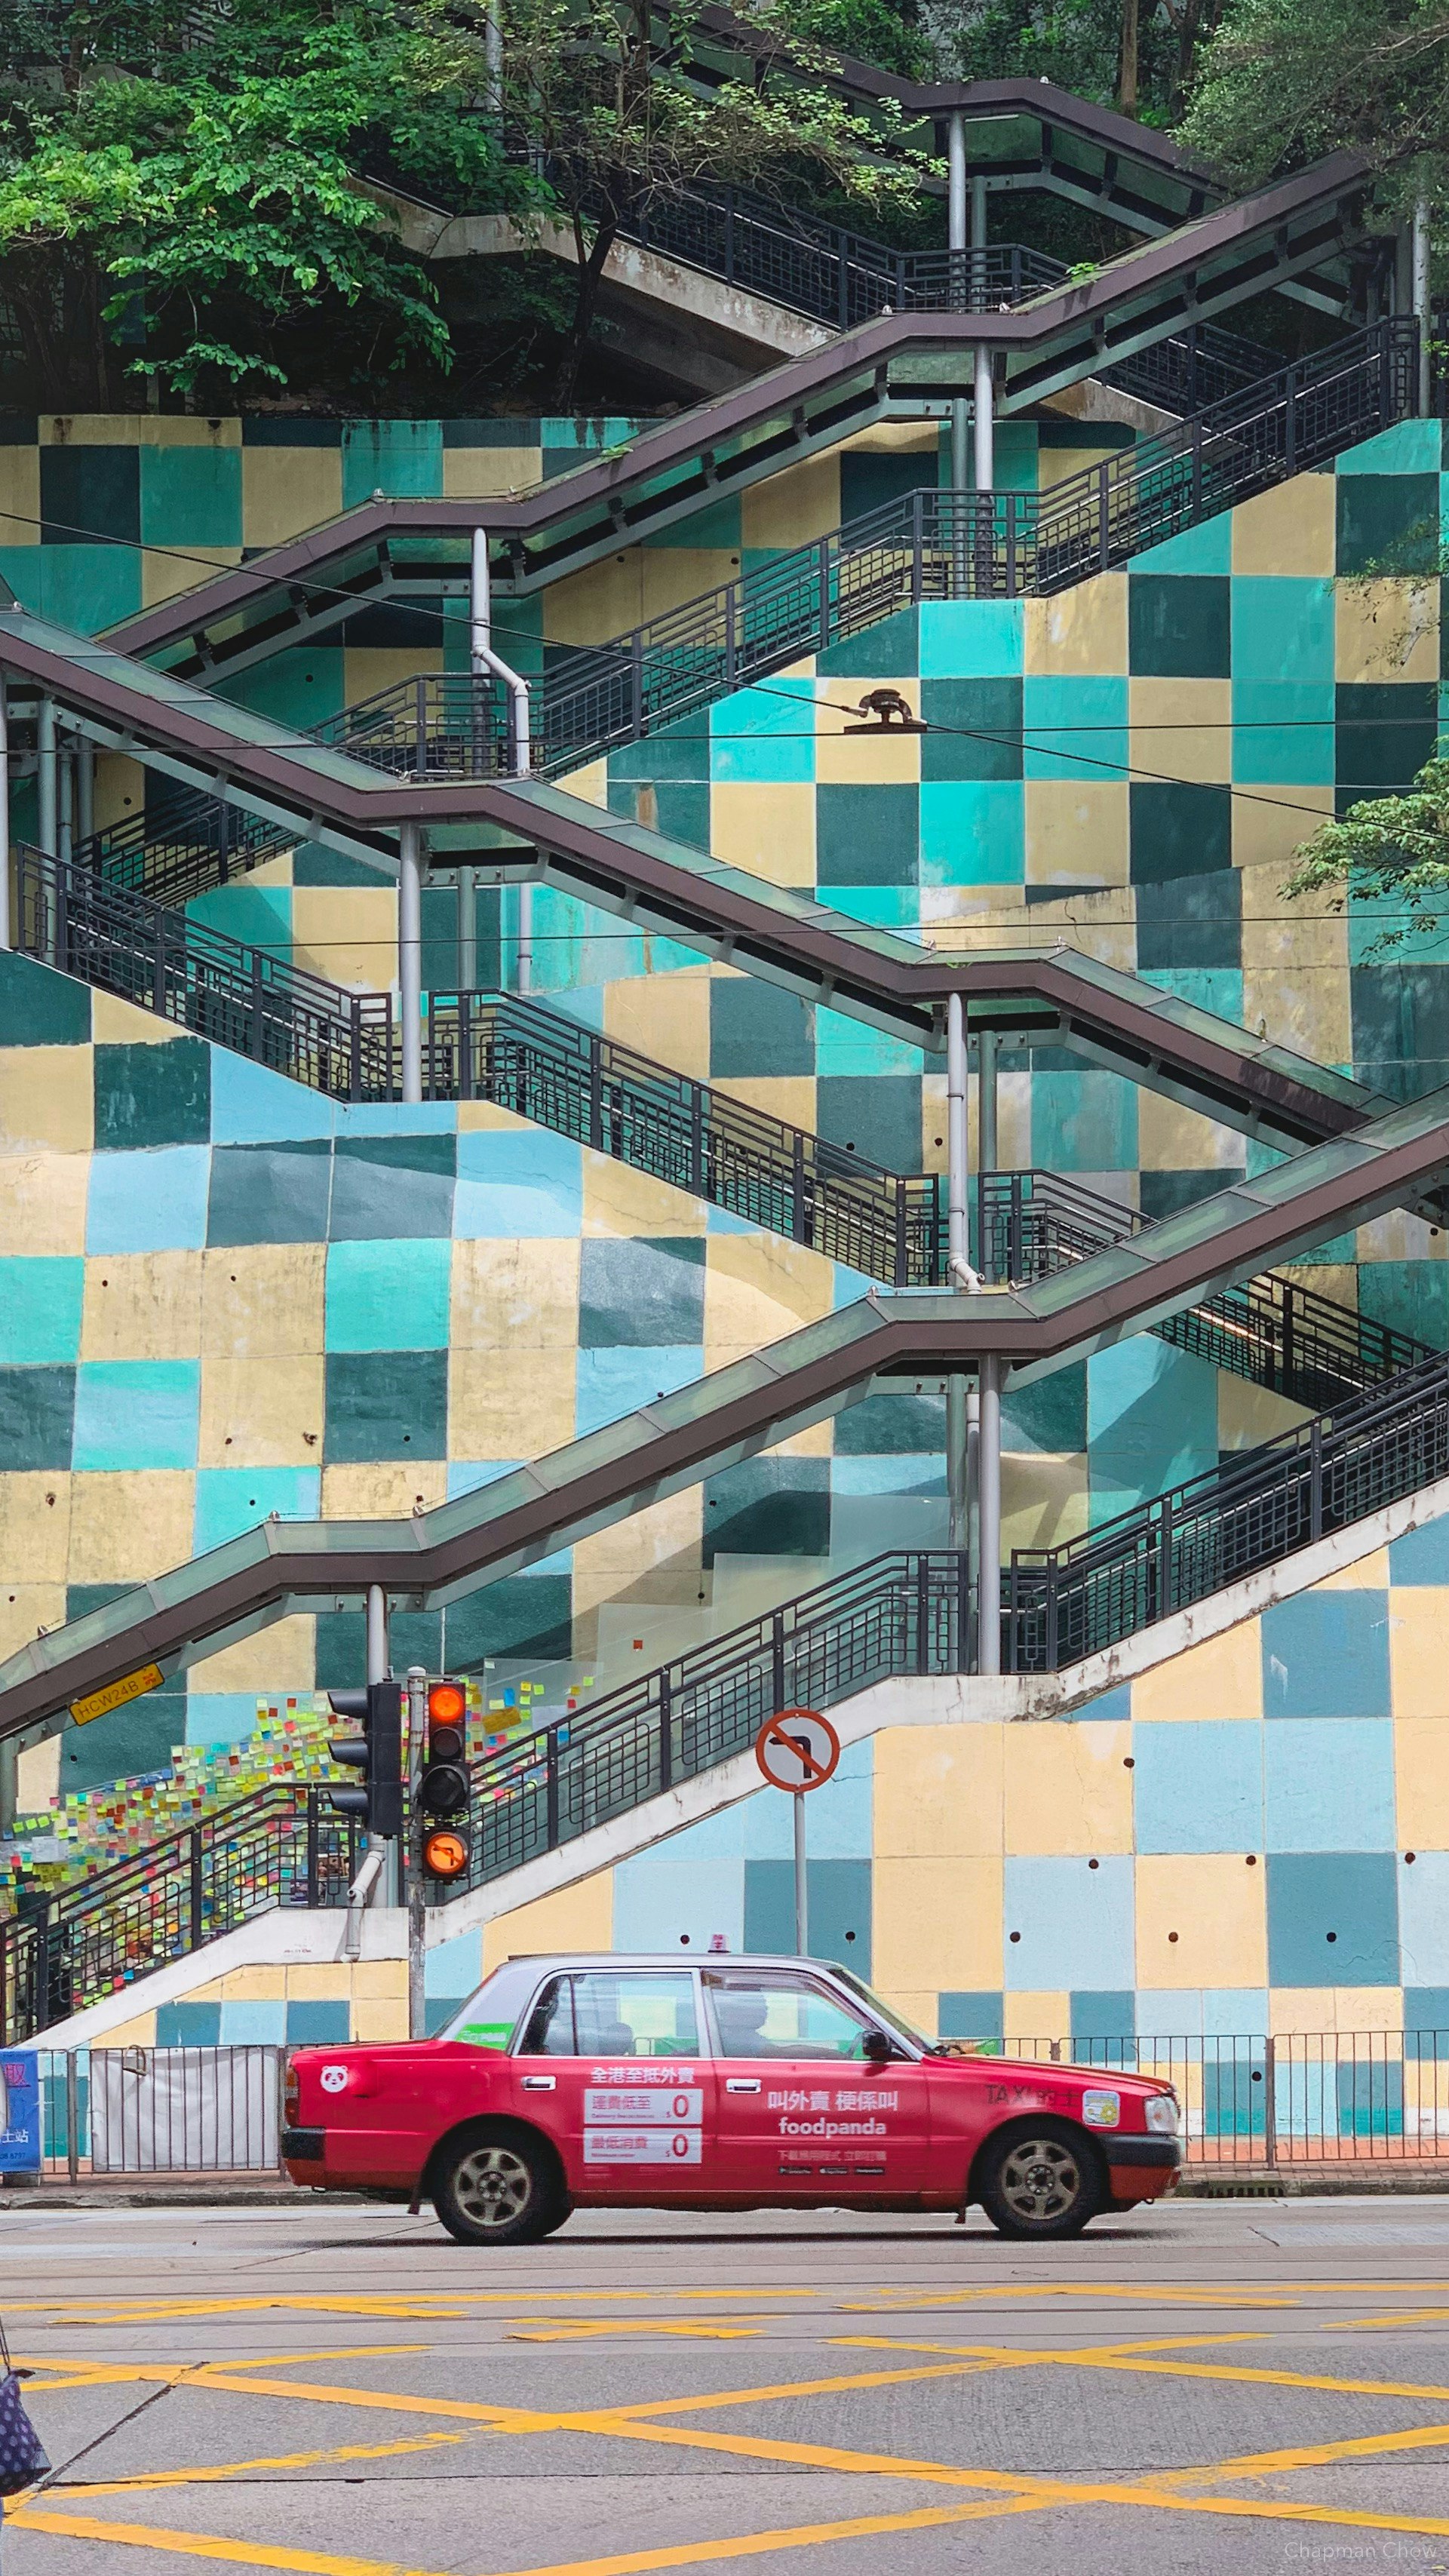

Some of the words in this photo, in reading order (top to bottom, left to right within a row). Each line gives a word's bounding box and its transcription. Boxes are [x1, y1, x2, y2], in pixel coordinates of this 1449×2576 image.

[77, 1680, 139, 1718] HCW24B
[591, 2067, 695, 2084] 全港至抵外賣
[767, 2090, 830, 2111] 叫外賣
[835, 2090, 898, 2111] 梗係叫
[0, 2128, 29, 2144] 士站
[778, 2116, 887, 2139] foodpanda
